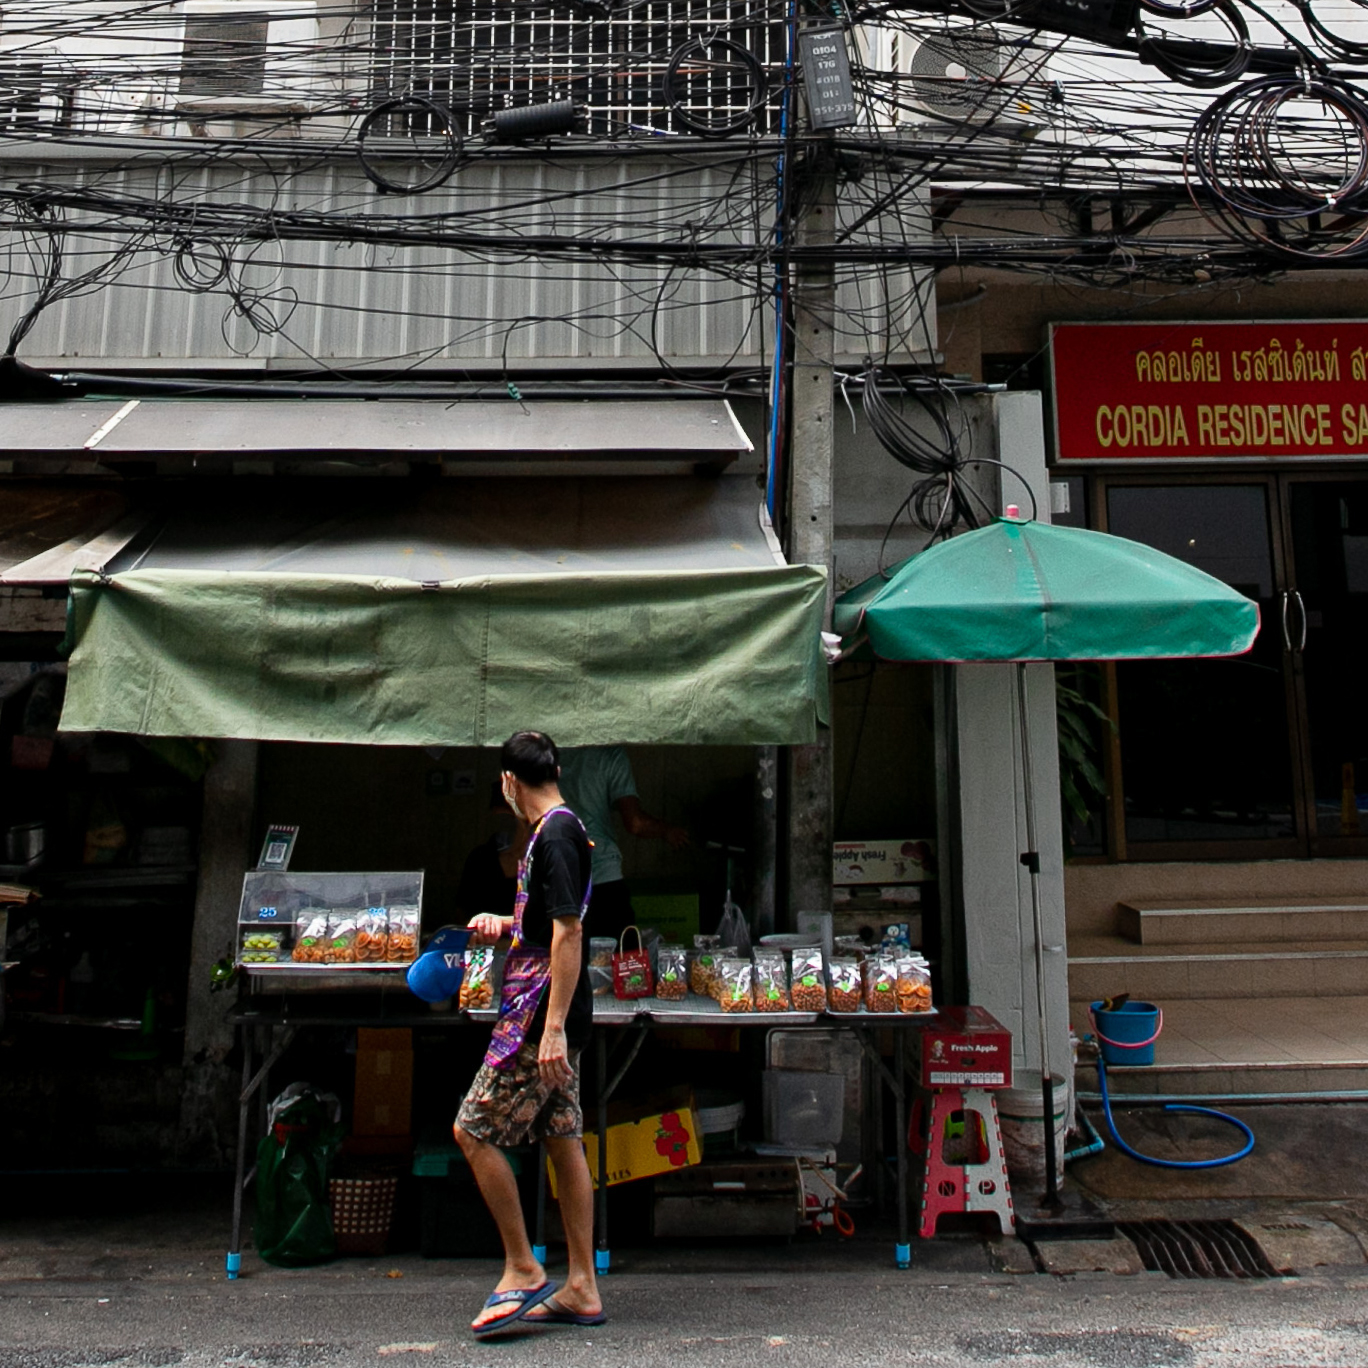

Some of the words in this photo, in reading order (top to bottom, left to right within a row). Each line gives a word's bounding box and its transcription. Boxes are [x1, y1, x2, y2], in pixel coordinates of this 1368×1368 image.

[1135, 337, 1221, 382] คลอเดีย
[1232, 338, 1341, 382] เรสซิเด้นท์
[1095, 404, 1189, 448] CORDIA
[1197, 404, 1334, 447] RESIDENCE
[259, 906, 278, 919] 25
[950, 1044, 974, 1052] Fresh
